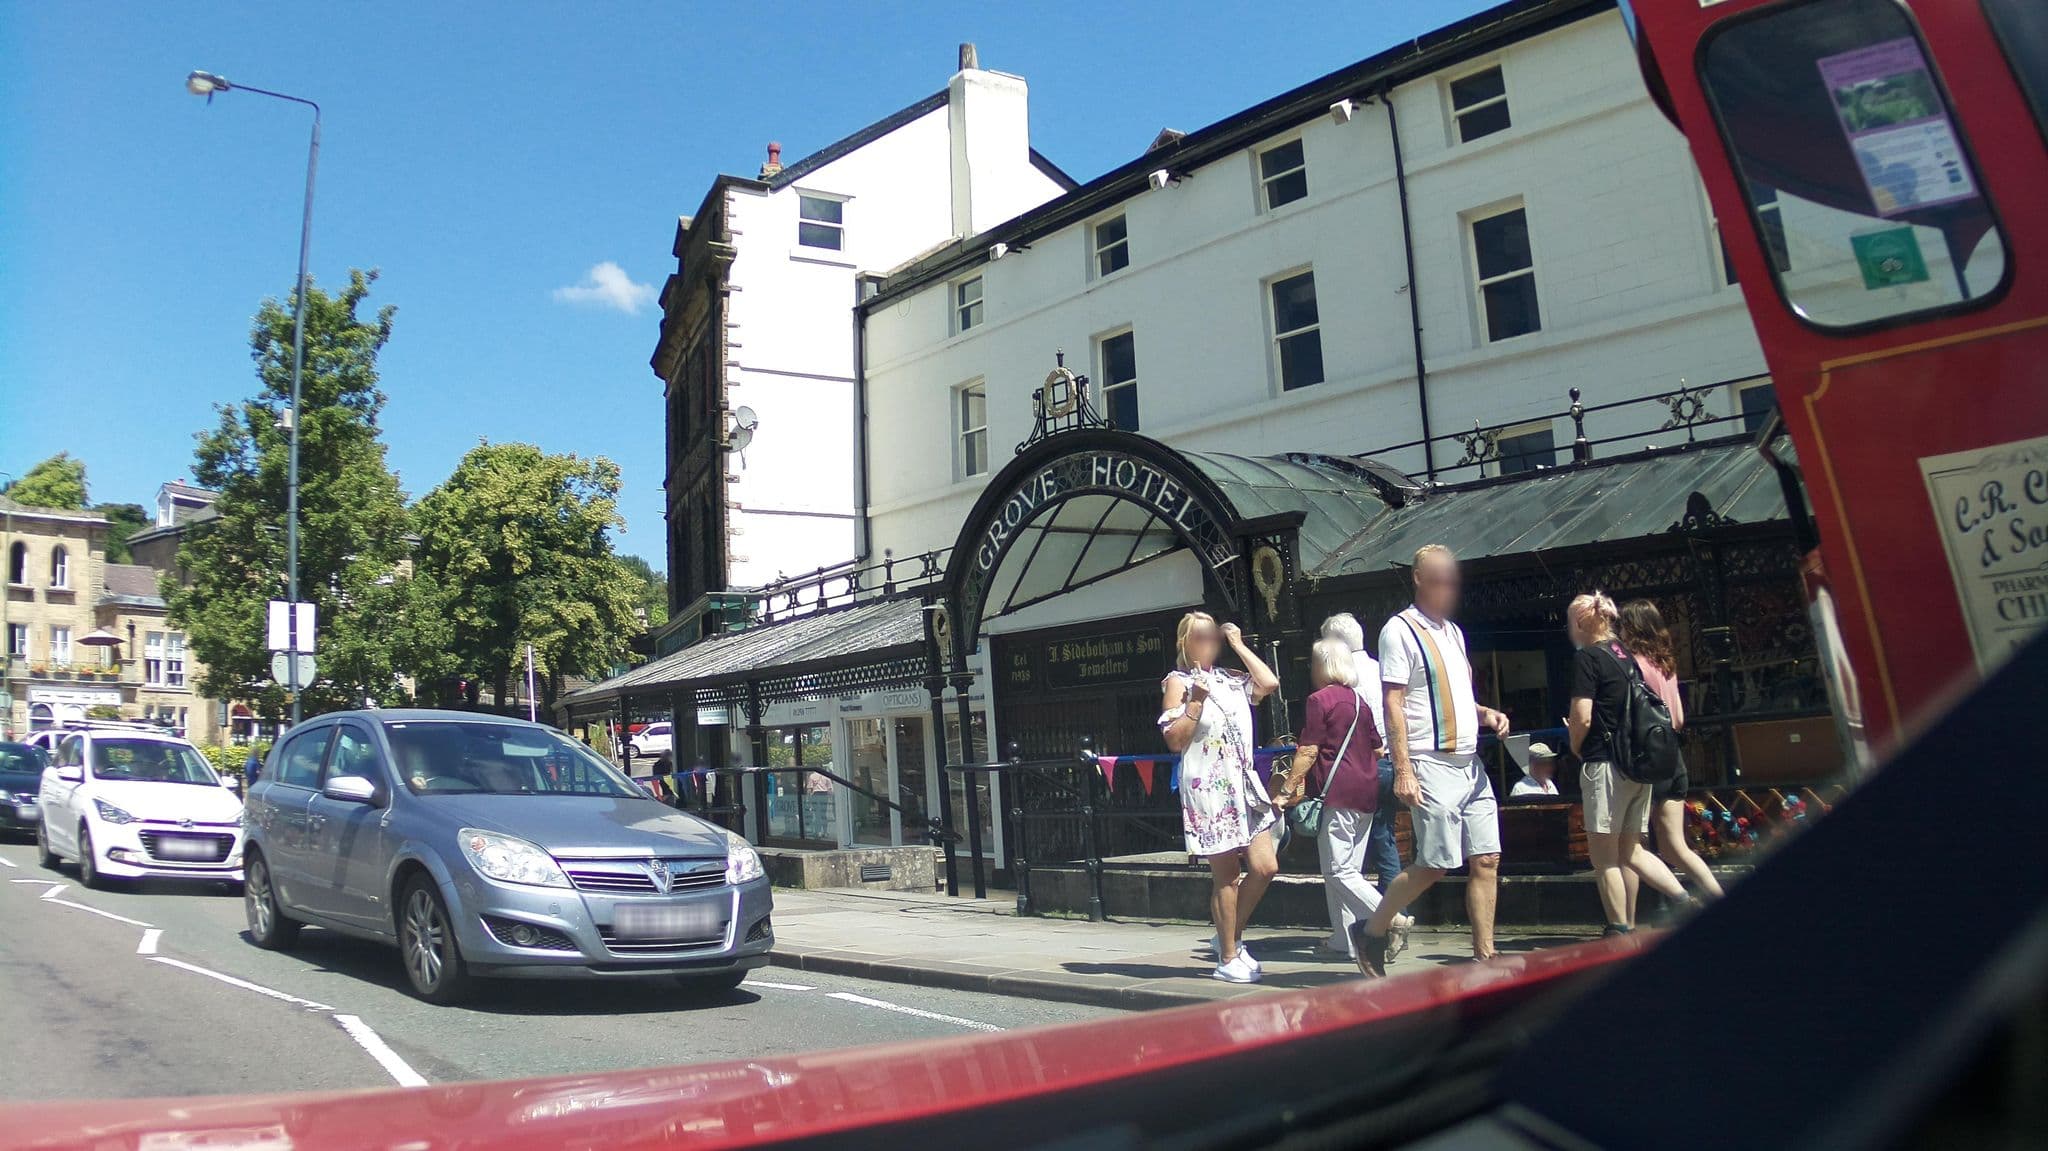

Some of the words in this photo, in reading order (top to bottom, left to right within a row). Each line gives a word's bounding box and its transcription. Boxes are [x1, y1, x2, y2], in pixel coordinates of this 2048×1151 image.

[2024, 470, 2048, 505] C
[977, 469, 1057, 570] GROVE
[1092, 456, 1195, 532] HOTEL
[2009, 517, 2048, 554] So
[1062, 639, 1124, 662] Sidebotham
[1126, 640, 1134, 653] &
[1136, 632, 1162, 655] Son
[1079, 658, 1129, 677] Jewellers
[882, 692, 919, 706] OPTICIANS
